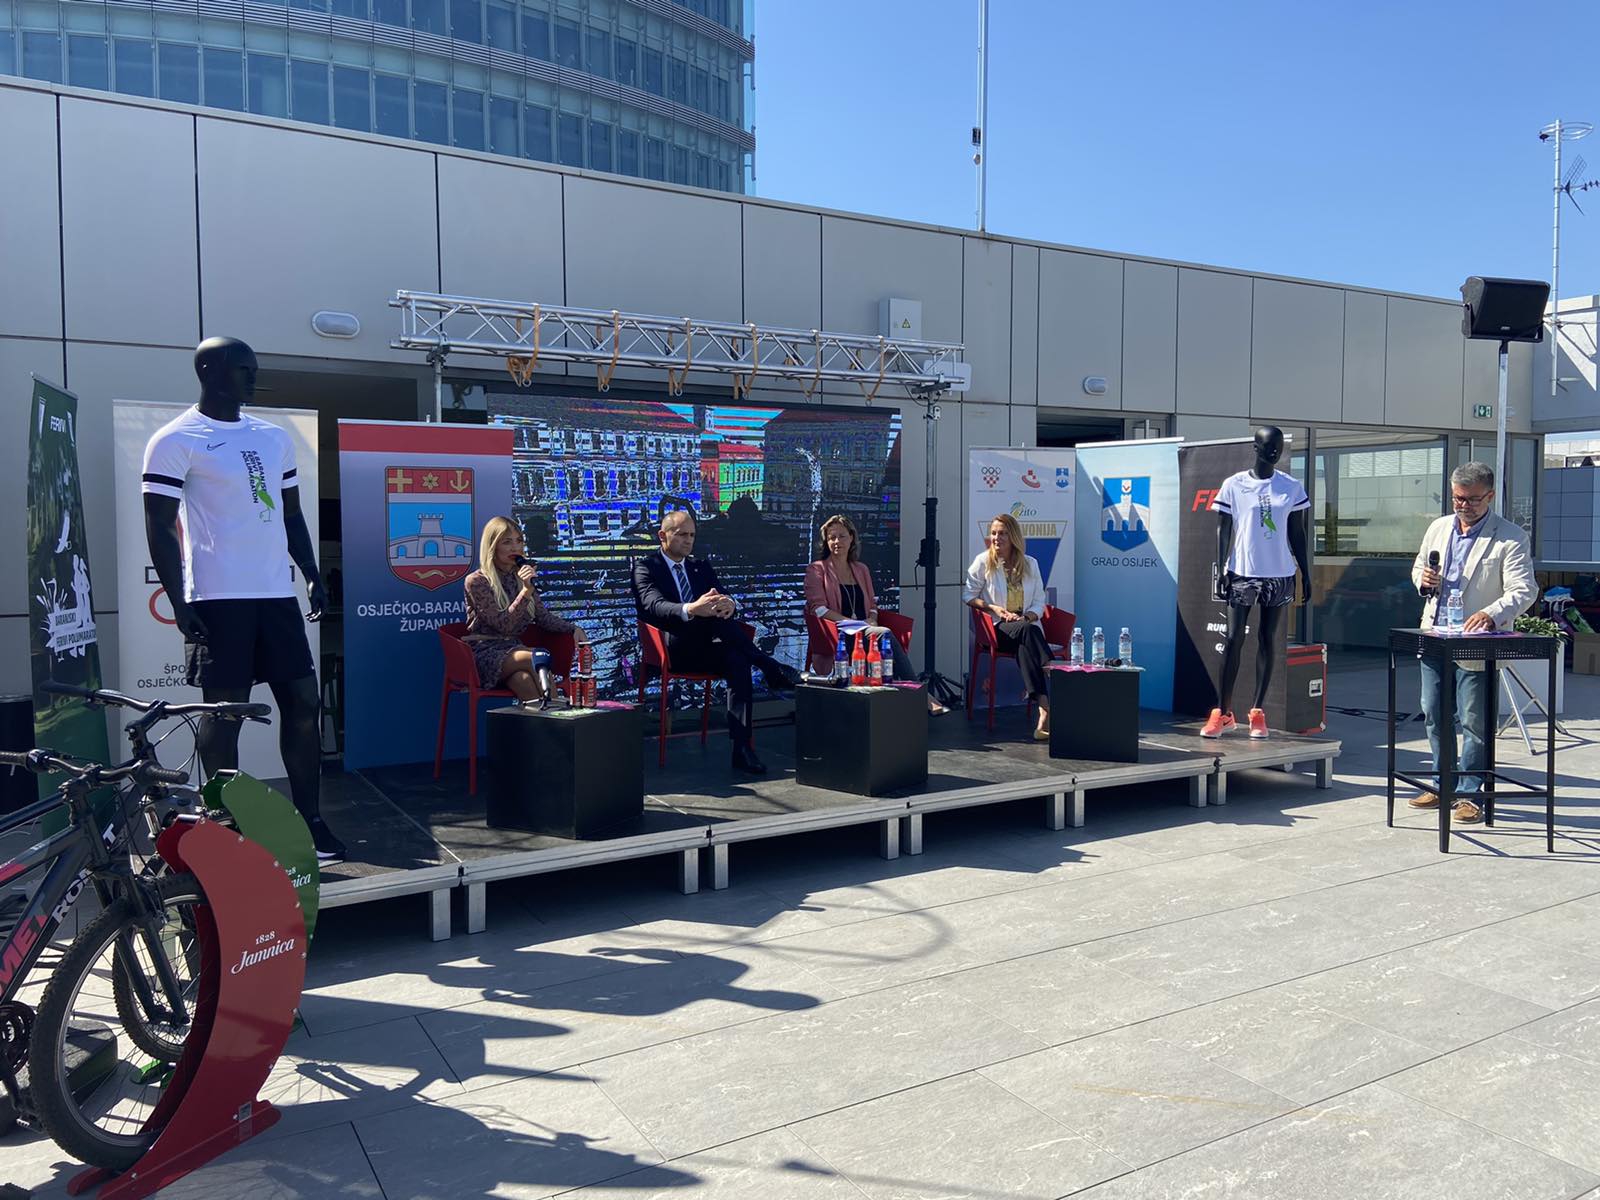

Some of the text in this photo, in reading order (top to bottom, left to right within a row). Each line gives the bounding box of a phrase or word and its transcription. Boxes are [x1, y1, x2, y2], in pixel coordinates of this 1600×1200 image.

[1091, 557, 1158, 568] GRAD OSIJEK
[357, 600, 468, 617] OSJEČKO-BARAN
[164, 663, 187, 675] ŠPO
[137, 676, 188, 689] OSJEČKO
[255, 930, 275, 945] 1828
[230, 938, 295, 975] Jamnica
